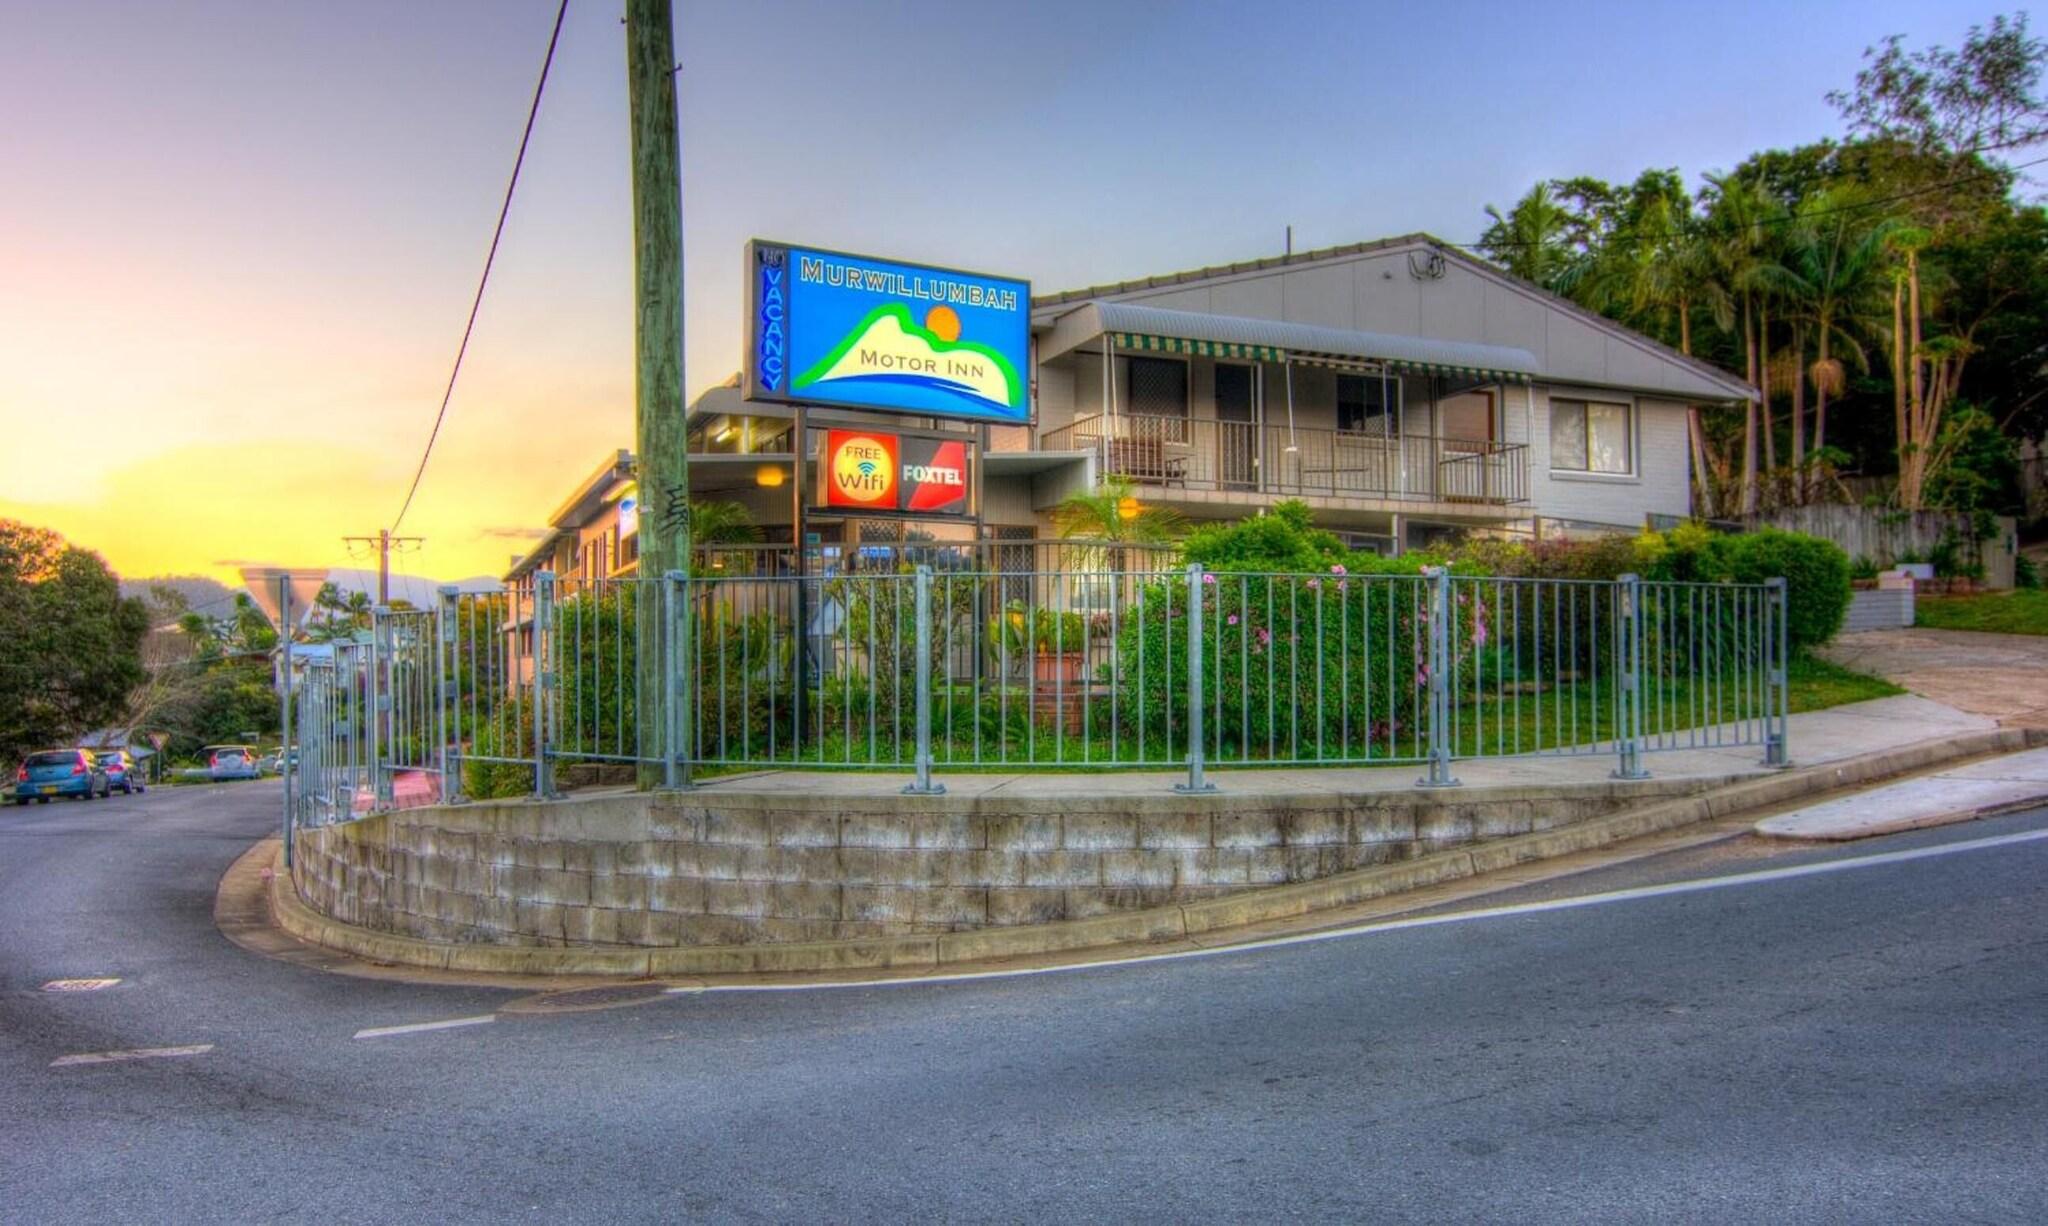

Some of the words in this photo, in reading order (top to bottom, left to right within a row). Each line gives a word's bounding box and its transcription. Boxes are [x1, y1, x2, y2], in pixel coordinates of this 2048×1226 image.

[801, 257, 1017, 311] MURWILLUMBAH
[763, 270, 783, 390] VACANCY
[861, 349, 935, 374] MOTOR
[949, 361, 984, 378] INN
[846, 446, 881, 460] FREE
[839, 473, 884, 490] Wifi
[903, 465, 962, 485] FOXTEL
